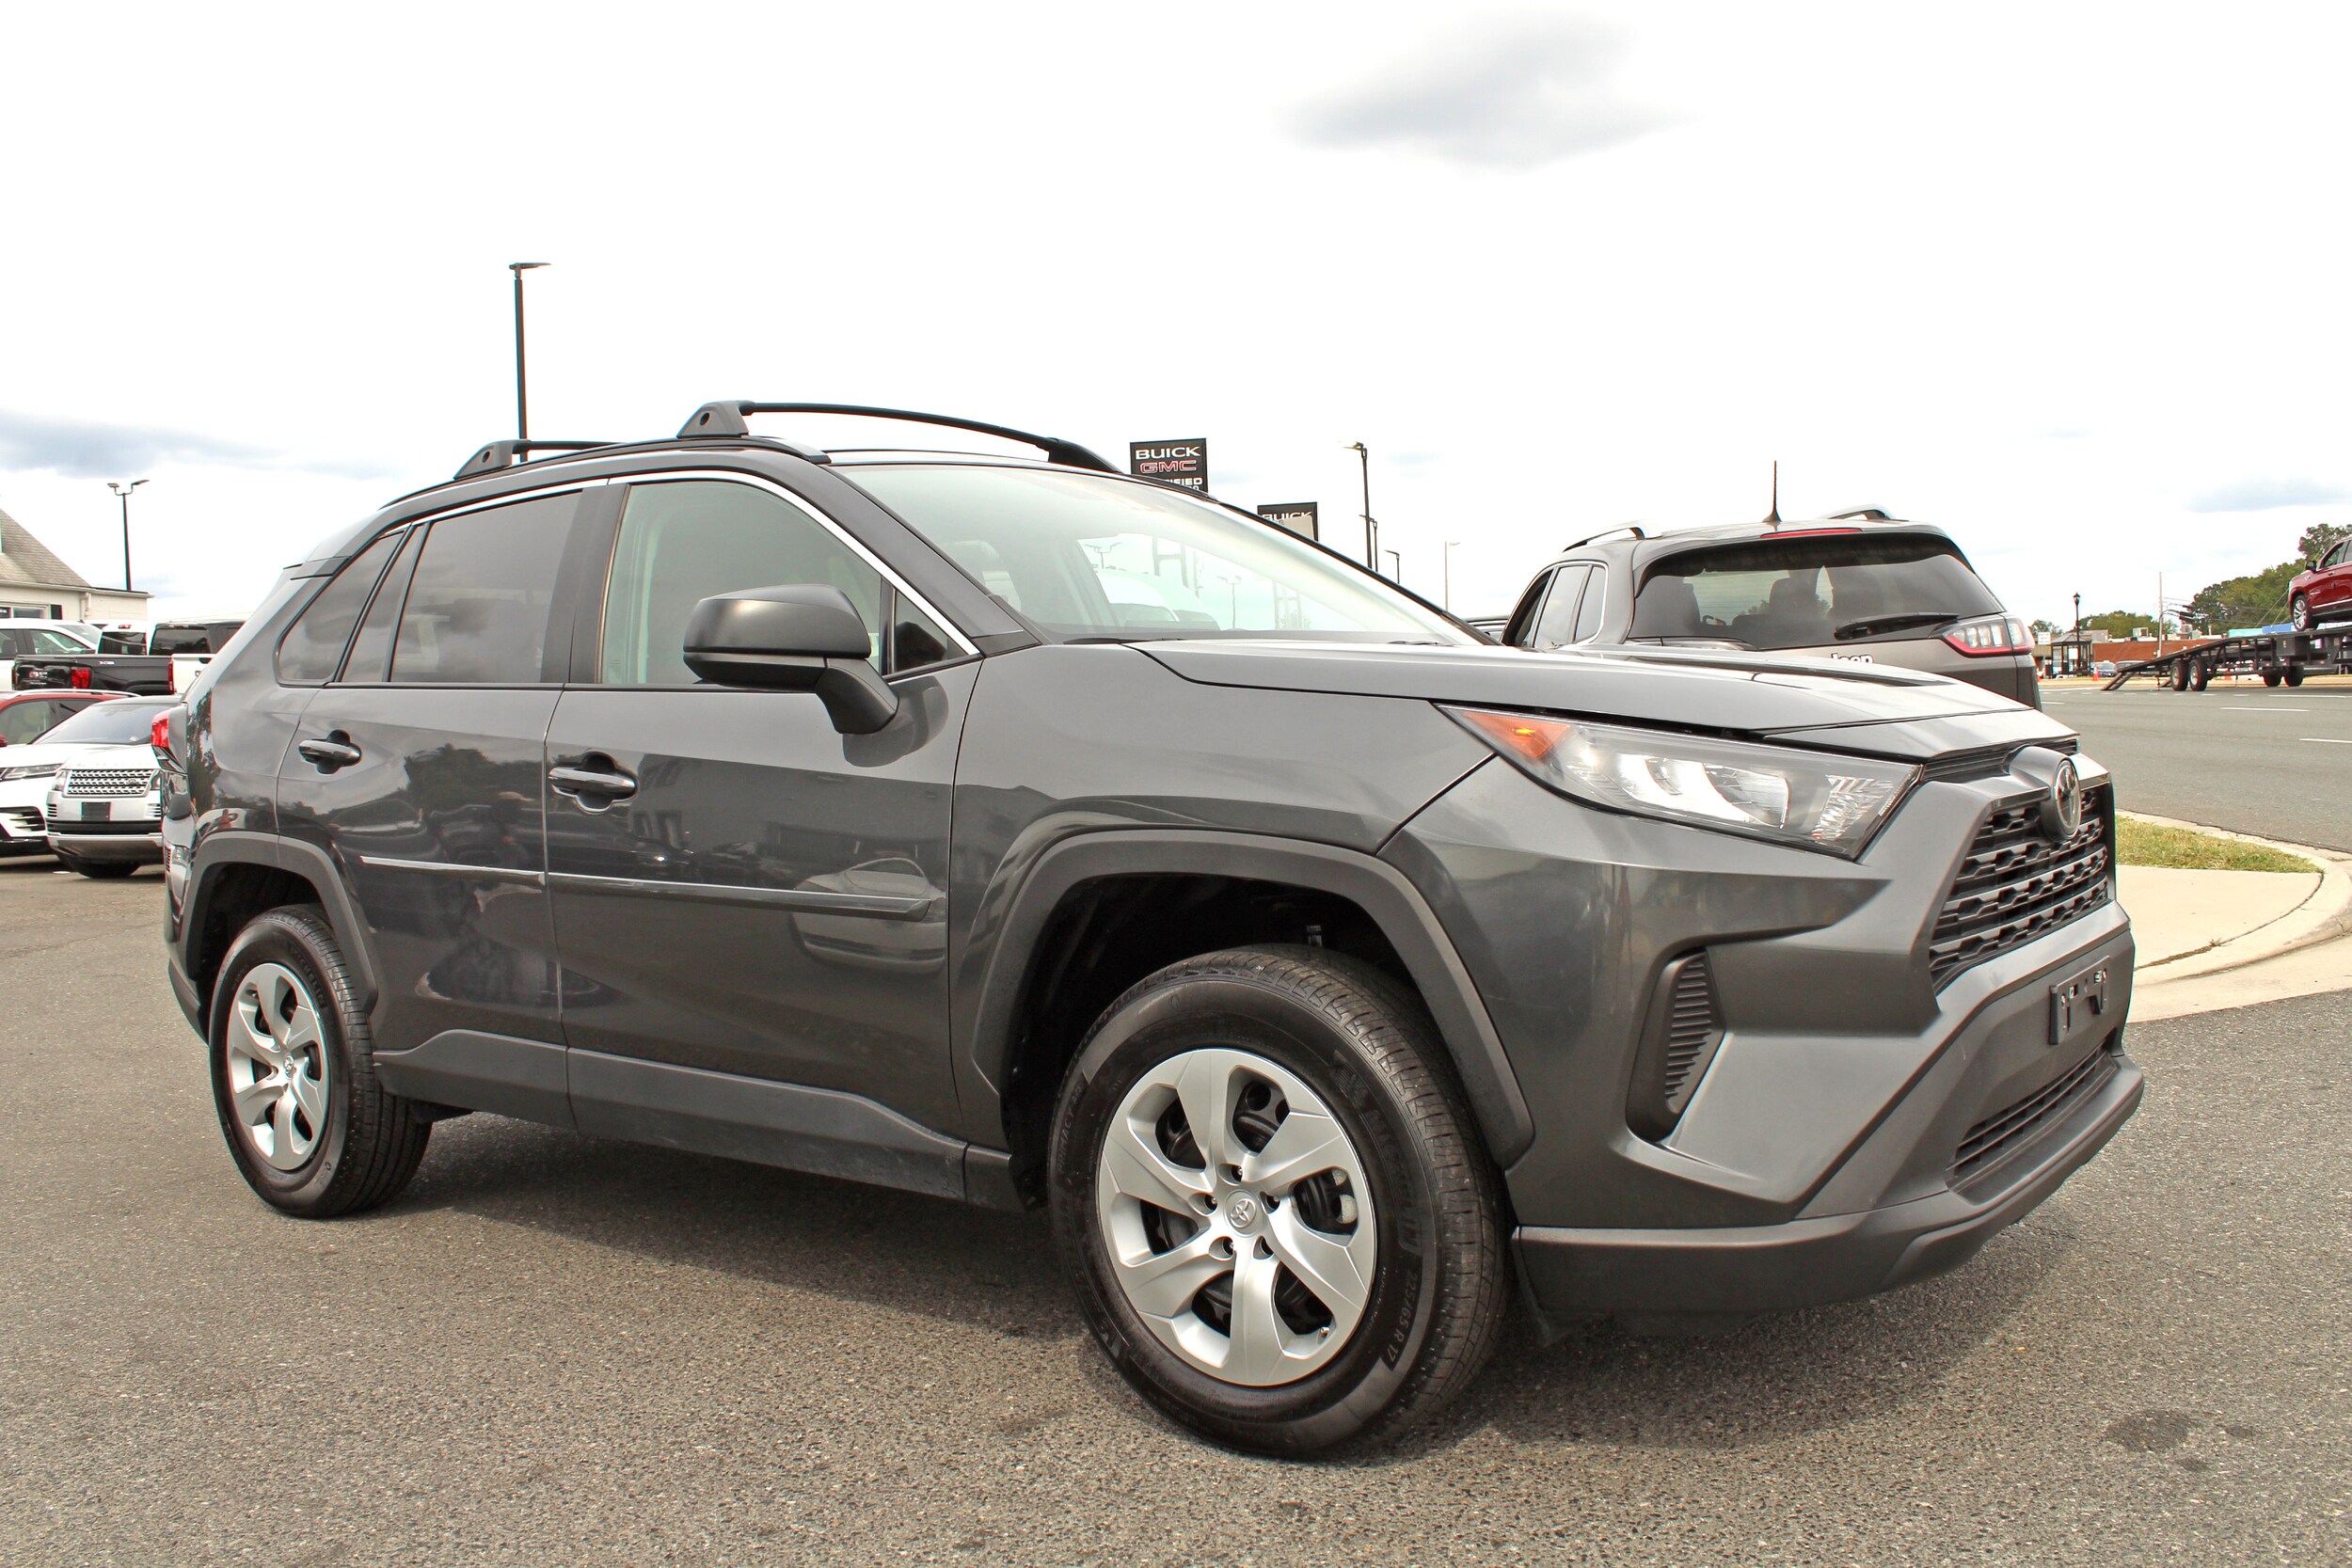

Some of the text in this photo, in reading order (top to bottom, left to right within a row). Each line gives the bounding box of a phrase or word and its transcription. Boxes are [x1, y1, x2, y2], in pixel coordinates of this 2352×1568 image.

[1136, 446, 1201, 460] BUICK
[1140, 459, 1197, 474] GMC
[1387, 1343, 1399, 1363] 17
